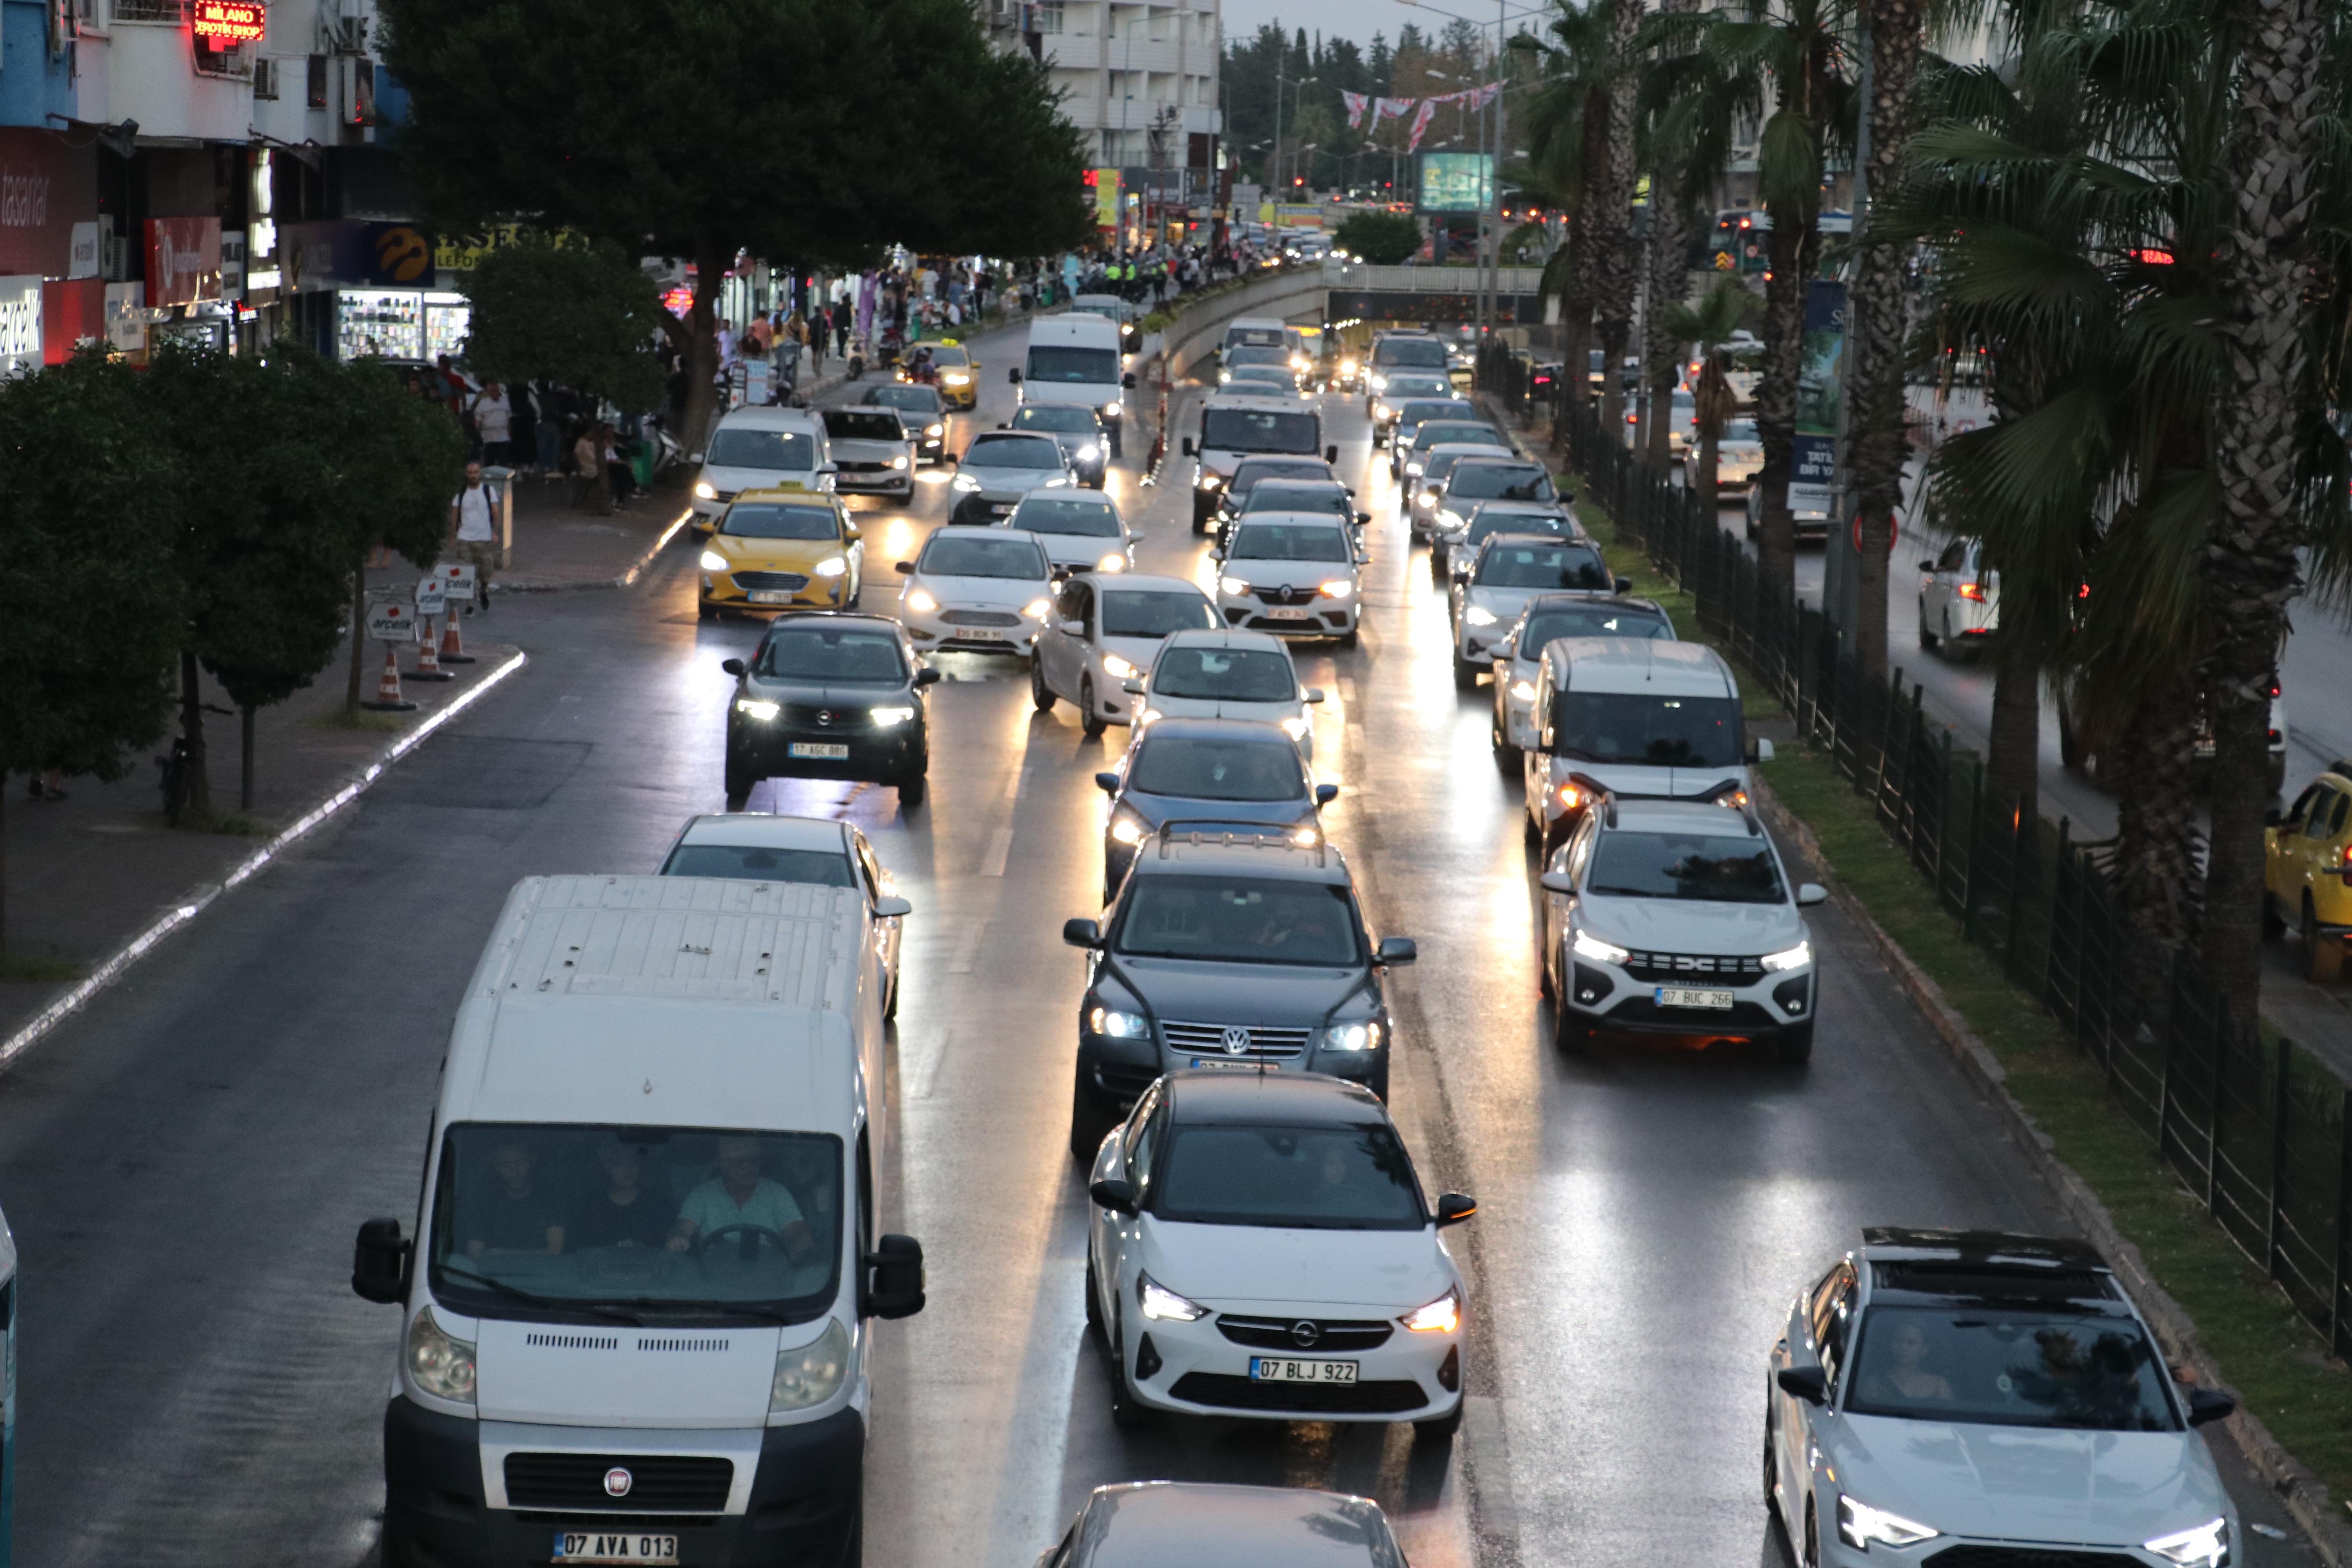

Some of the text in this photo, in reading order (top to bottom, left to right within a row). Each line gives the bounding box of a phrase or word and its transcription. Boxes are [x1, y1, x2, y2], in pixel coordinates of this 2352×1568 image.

[206, 5, 254, 23] MİLANO
[232, 25, 260, 37] SHOP
[372, 619, 412, 630] arçelik
[796, 746, 804, 754] 17
[1664, 991, 1731, 1005] 07 BUC 266
[1261, 1361, 1353, 1381] 07 BLJ 922
[565, 1535, 587, 1555] 07
[595, 1536, 628, 1556] AVA
[641, 1537, 675, 1557] 013
